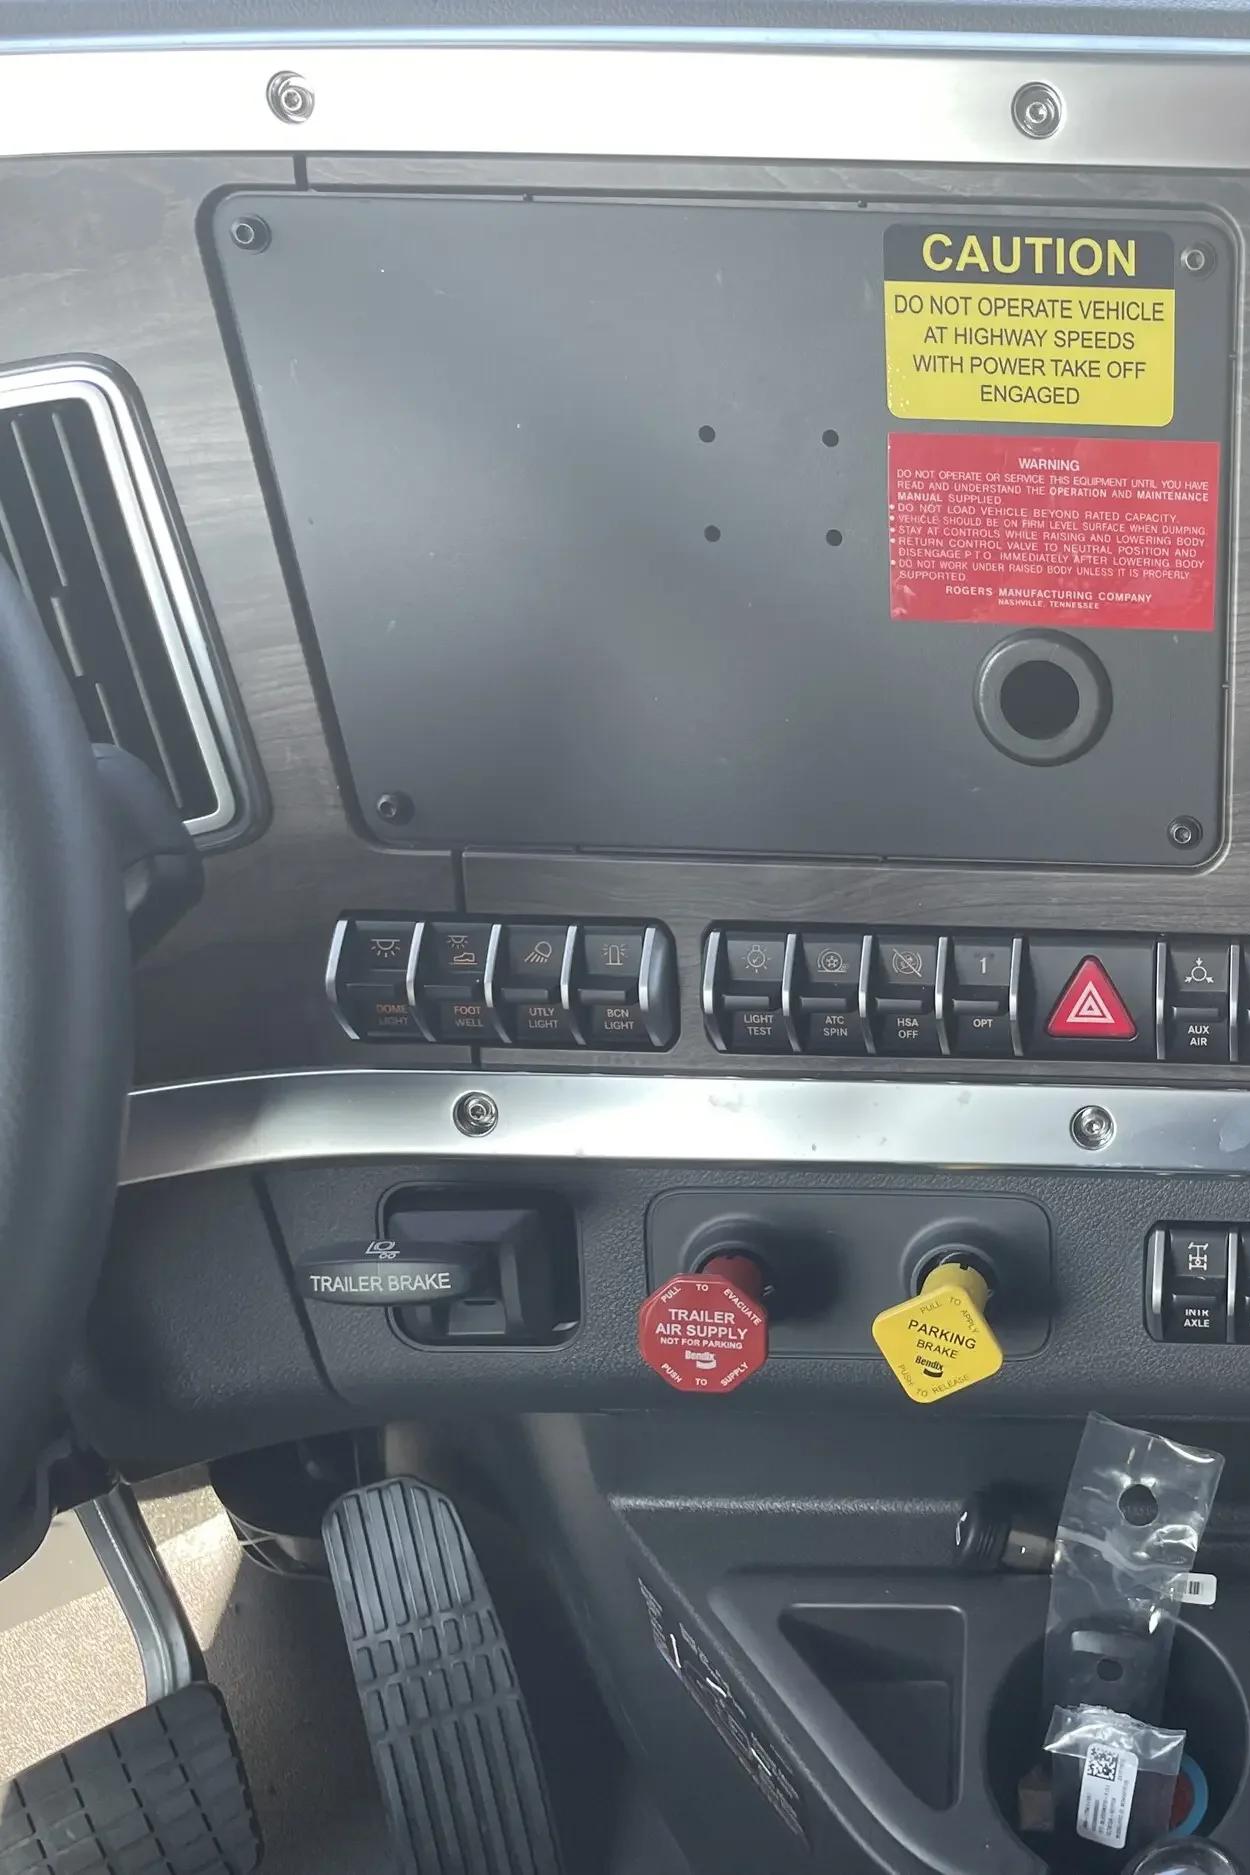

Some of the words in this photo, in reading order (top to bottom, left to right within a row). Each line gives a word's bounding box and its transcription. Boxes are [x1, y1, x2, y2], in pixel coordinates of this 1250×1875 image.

[922, 233, 1136, 276] CAUTION
[894, 294, 923, 314] DO
[930, 295, 972, 316] NOT
[978, 297, 1072, 319] OPERATE
[1079, 300, 1165, 322] VEHICLE
[924, 326, 947, 344] AT
[955, 327, 1047, 347] HIGHWAY
[1054, 329, 1135, 350] SPEEDS
[913, 354, 963, 373] WITH
[970, 356, 1045, 376] POWER
[1050, 358, 1100, 378] TAKE
[1107, 360, 1146, 380] OFF
[980, 385, 1080, 405] ENGAGED
[1018, 457, 1080, 471] WARNING
[896, 469, 911, 479] DO
[915, 470, 935, 479] NOT
[938, 470, 982, 481] OPERATE
[985, 472, 1001, 482] OR
[1004, 473, 1045, 484] SERVICE
[1050, 475, 1070, 486] THIS
[1073, 476, 1128, 488] EQUIPMENT
[1131, 478, 1158, 489] UNTIL
[1161, 479, 1182, 490] YOU
[1184, 481, 1209, 491] HAVE
[897, 481, 924, 490] READ
[928, 482, 950, 491] AND
[954, 483, 1022, 495] UNDERSTAND
[1026, 485, 1045, 496] THE
[1050, 486, 1107, 498] OPERATION
[1111, 489, 1132, 499] AND
[1136, 490, 1209, 502] MAINTENANCE
[897, 491, 943, 502] MANUAL
[897, 503, 914, 512] DO
[919, 504, 942, 513] NOT
[947, 505, 976, 515] LOAD
[980, 506, 1028, 517] VEHICLE
[1033, 508, 1079, 520] BEYOND
[1085, 510, 1120, 521] RATED
[898, 525, 923, 535] STAY
[927, 526, 942, 536] AT
[943, 527, 1001, 539] CONTROLS
[1005, 530, 1038, 540] WHILE
[1043, 531, 1085, 542] RAISING
[1090, 534, 1111, 543] AND
[1116, 535, 1172, 546] LOWERING
[1176, 537, 1206, 547] BODY
[945, 585, 993, 596] ROGERS
[998, 588, 1093, 601] MANUFACTURING
[1098, 591, 1152, 603] COMPANY
[979, 957, 988, 974] 1
[454, 1005, 482, 1016] FOOT
[529, 1007, 555, 1018] UTLY
[607, 1008, 630, 1019] BCN
[378, 1016, 408, 1026] LIGHT
[455, 1017, 485, 1028] WELL
[528, 1019, 559, 1030] LIGHT
[604, 1020, 634, 1031] LIGHT
[743, 1014, 774, 1025] LIGHT
[825, 1015, 845, 1026] ATC
[896, 1017, 919, 1028] HSA
[973, 1018, 993, 1029] OPT
[746, 1025, 773, 1036] TEST
[823, 1027, 848, 1038] SPIN
[898, 1029, 919, 1040] OFF
[1187, 1025, 1210, 1035] AUX
[1189, 1036, 1208, 1046] AIR
[310, 1275, 383, 1292] TRAILER
[388, 1272, 451, 1292] BRAKE
[660, 1286, 682, 1304] PULL
[695, 1284, 709, 1292] TO
[723, 1288, 762, 1327] EVACUATE
[668, 1308, 736, 1325] TRAILER
[919, 1301, 943, 1315] PULL
[950, 1296, 962, 1306] TO
[960, 1309, 980, 1334] APPLY
[655, 1322, 682, 1335] AIR
[686, 1324, 749, 1340] SUPPLY
[1183, 1319, 1210, 1328] AXLE
[907, 1319, 977, 1350] PARKING
[660, 1337, 680, 1346] NOT
[681, 1338, 701, 1347] FOR
[702, 1340, 743, 1350] PARKING
[916, 1339, 959, 1360] BRAKE
[684, 1350, 716, 1361] Bendix
[915, 1355, 944, 1371] Bendix
[660, 1363, 683, 1383] PUSH
[695, 1378, 708, 1386] TO
[720, 1361, 750, 1387] SUPPLY
[916, 1387, 928, 1398] TO
[931, 1374, 970, 1395] RELEASE
